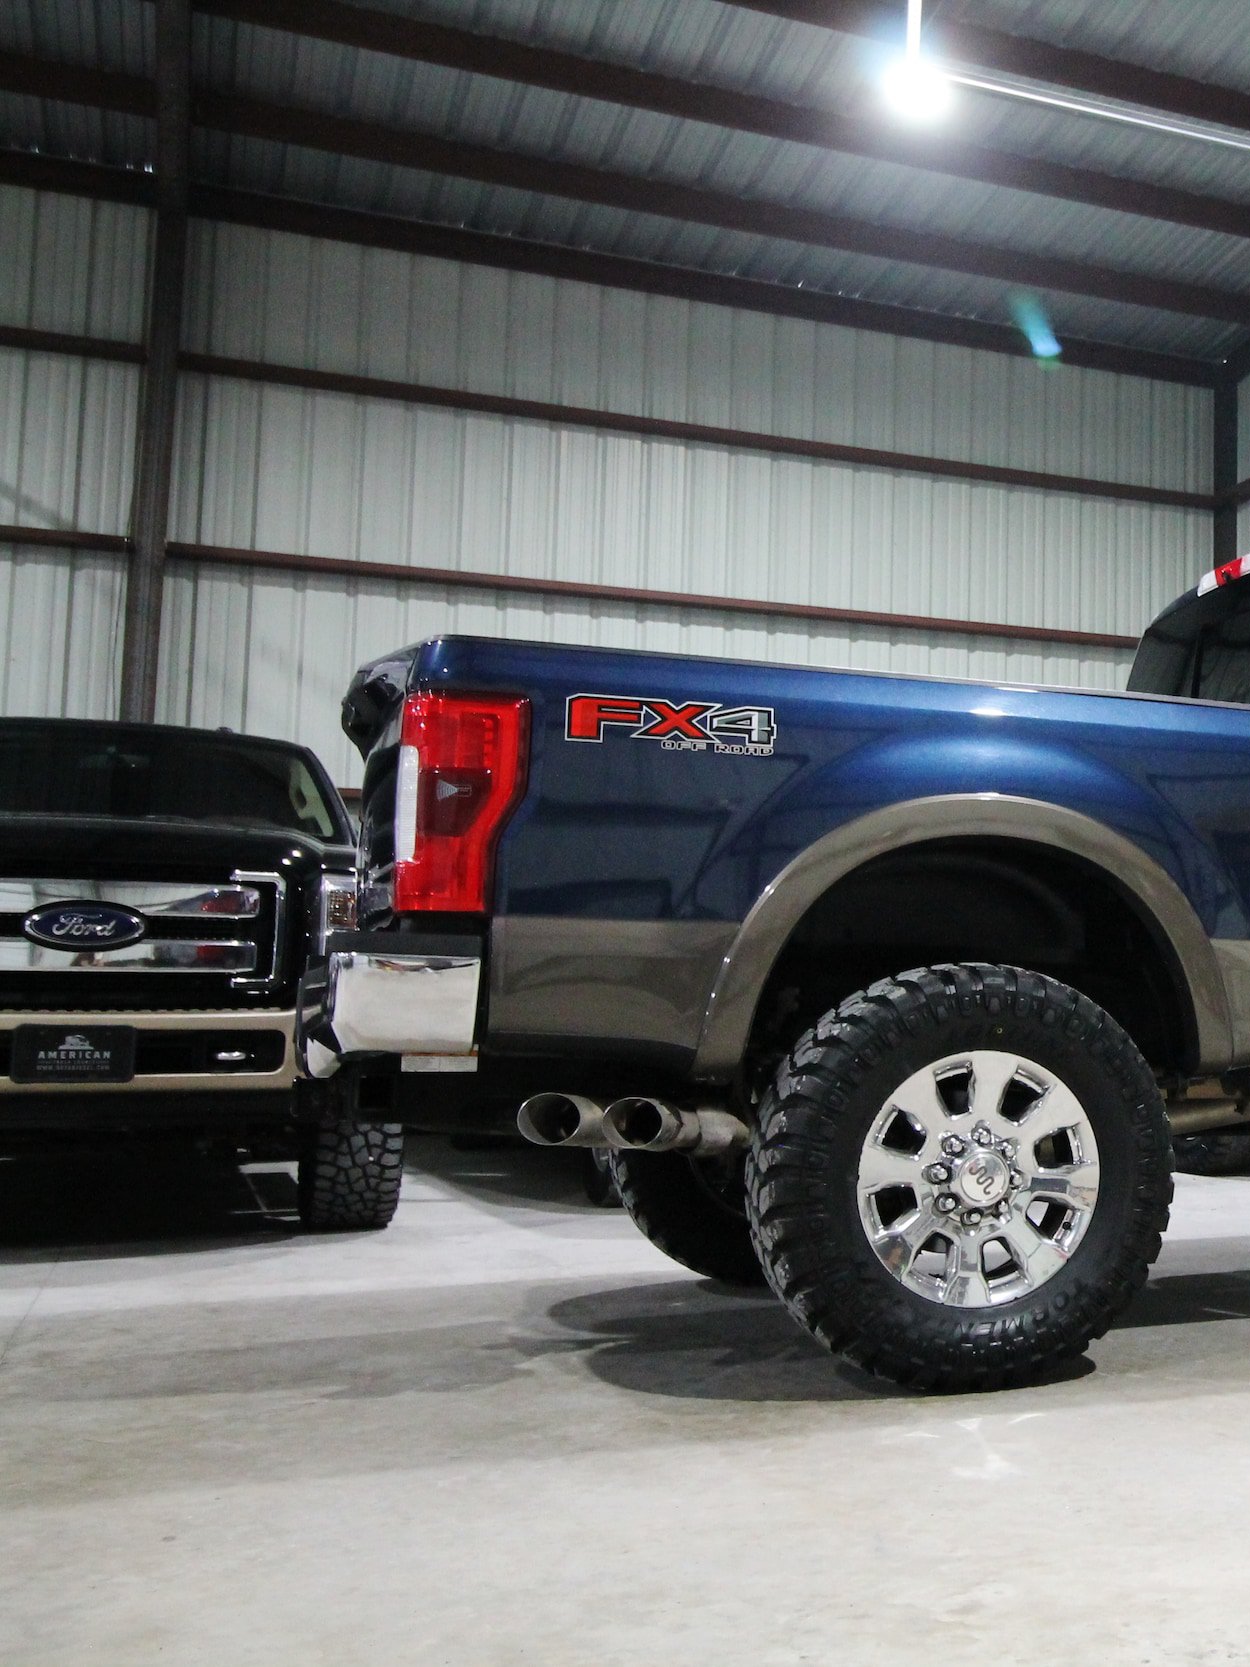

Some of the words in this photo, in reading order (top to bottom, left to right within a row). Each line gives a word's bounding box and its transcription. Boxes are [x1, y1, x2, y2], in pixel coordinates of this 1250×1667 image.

[564, 693, 777, 746] FX4
[660, 740, 707, 752] OFF
[714, 743, 774, 757] ROAD
[51, 912, 117, 937] Ford
[38, 1050, 111, 1060] AMERICAN
